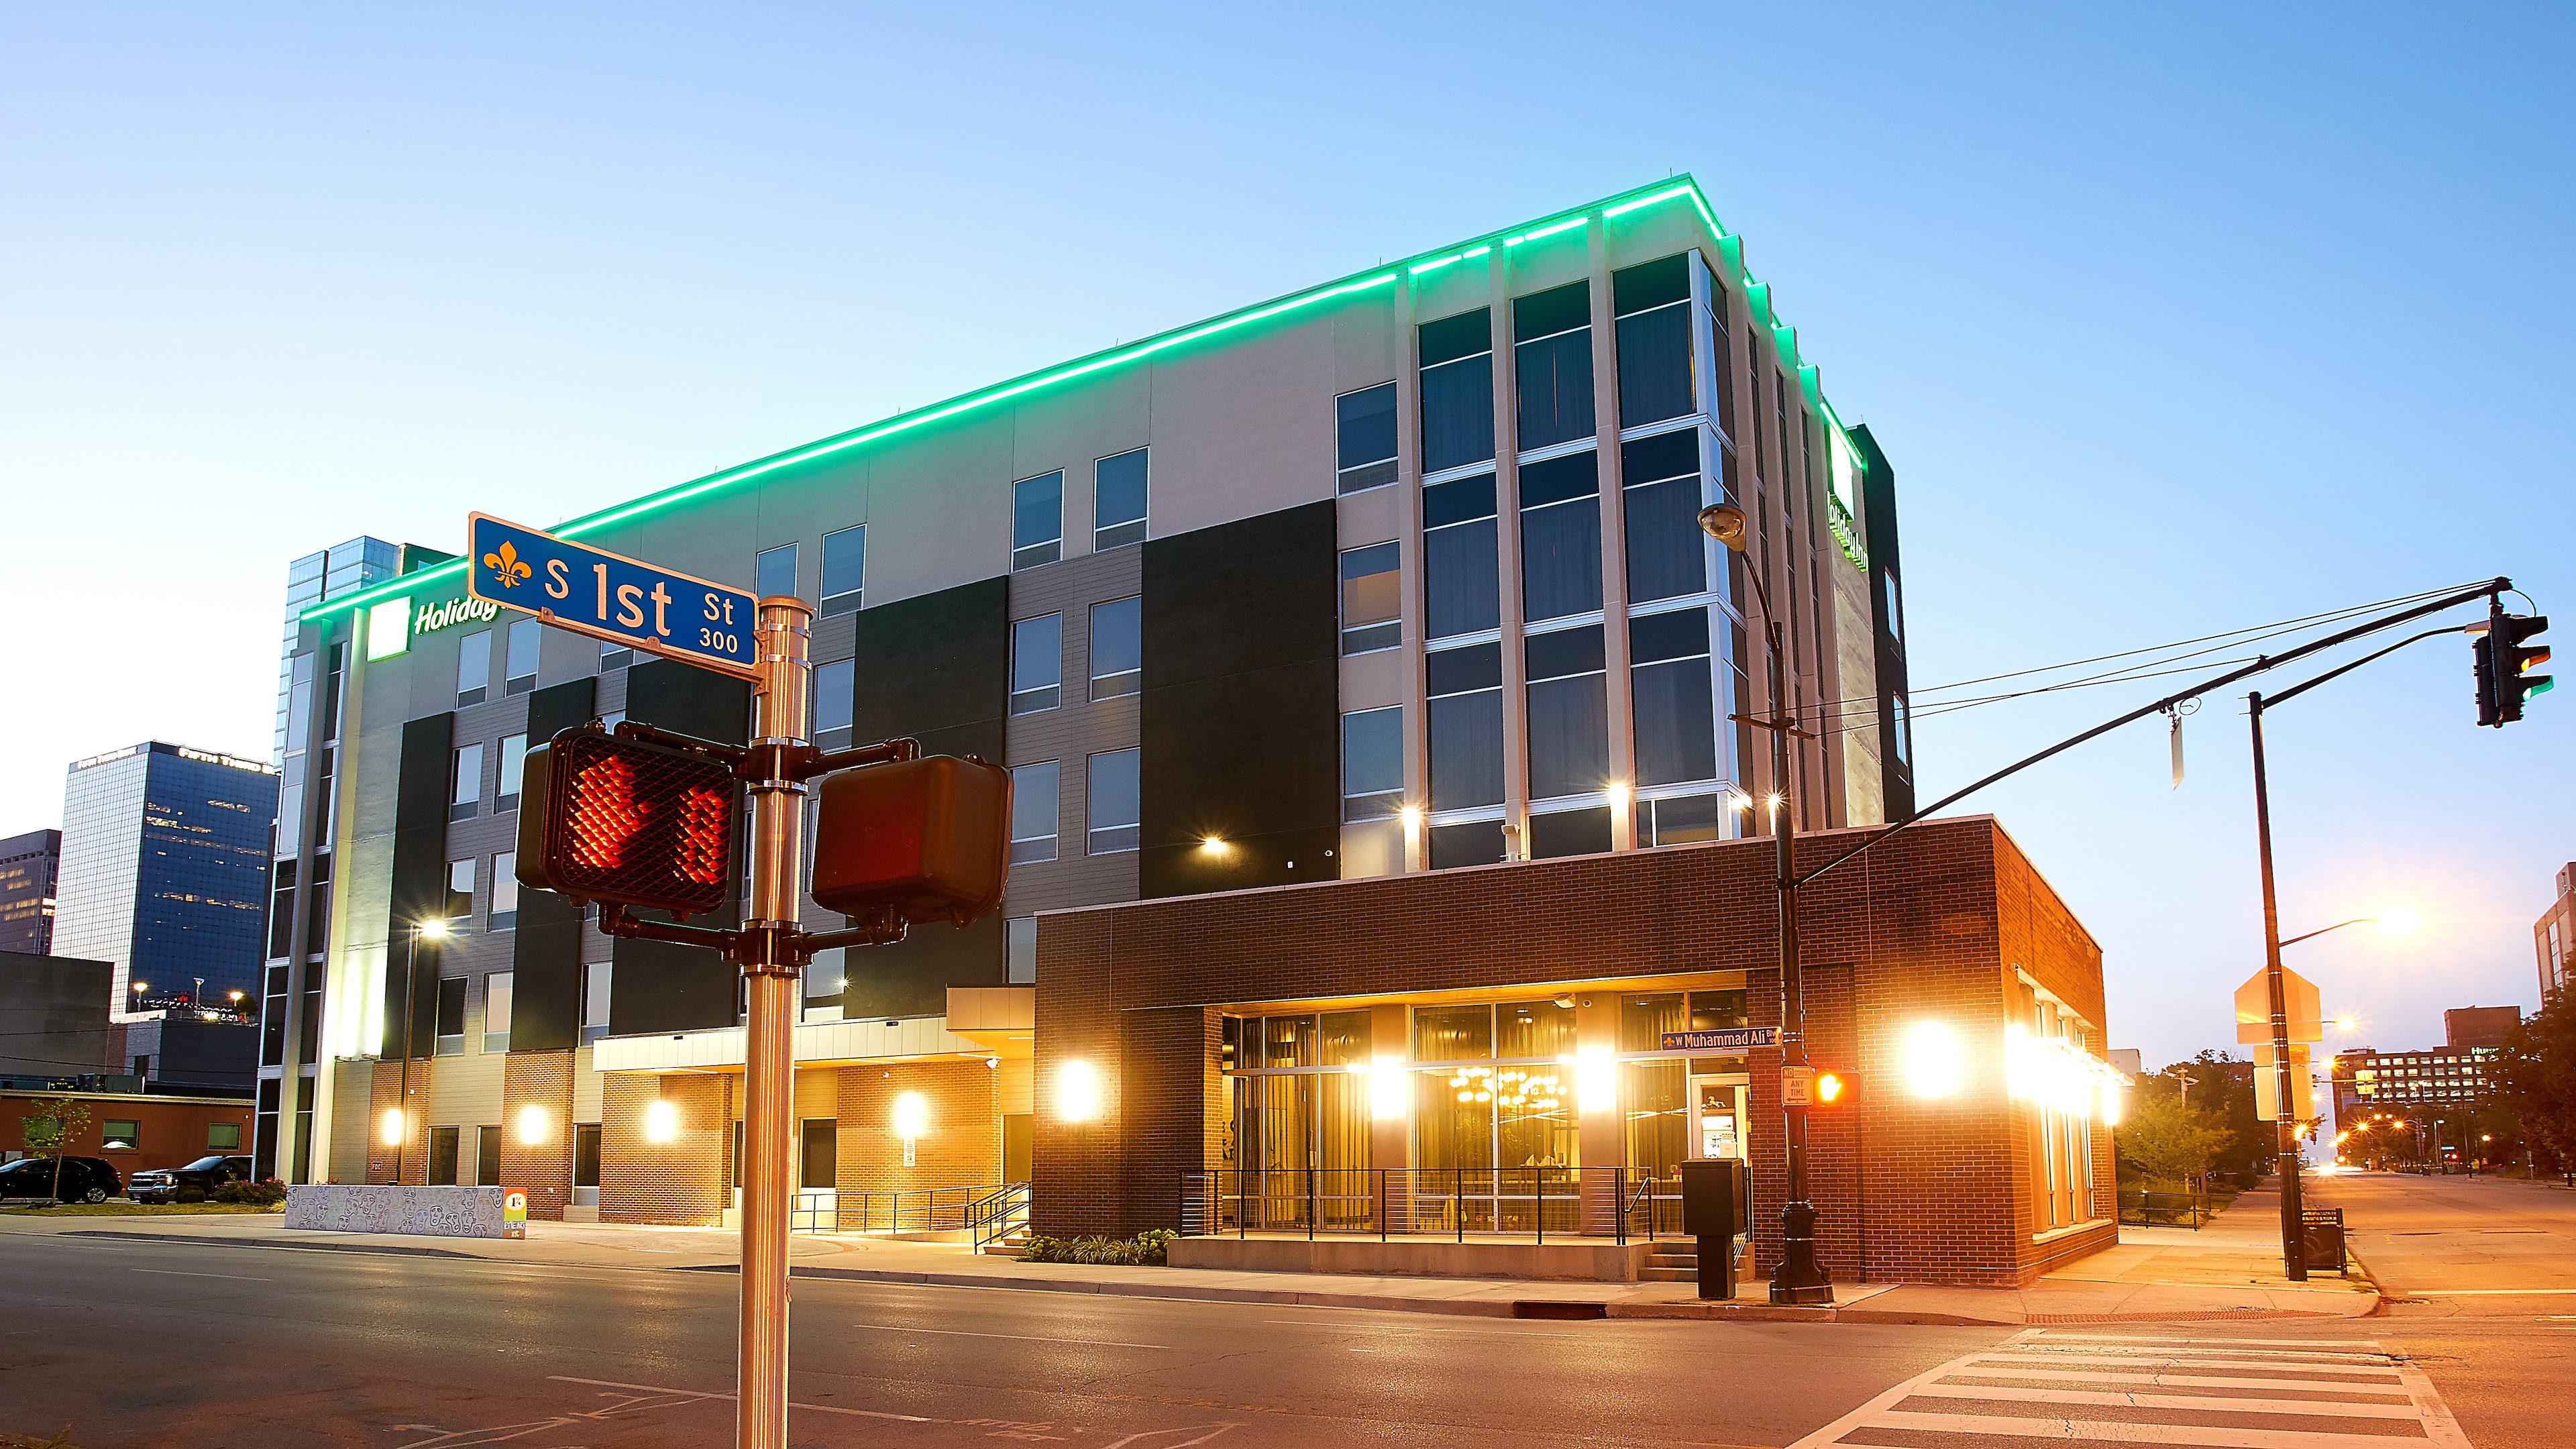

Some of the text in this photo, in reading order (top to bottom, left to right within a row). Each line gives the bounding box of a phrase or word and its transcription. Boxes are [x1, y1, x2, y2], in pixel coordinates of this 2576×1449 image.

[1856, 532, 1869, 572] Inn
[545, 559, 734, 637] S 1st St
[414, 594, 498, 635] Holiday
[699, 628, 739, 653] 300
[178, 747, 218, 764] FIFTH
[1675, 1036, 1682, 1046] W
[1684, 1031, 1748, 1048] Muhammad
[1750, 1030, 1766, 1044] Ali
[1784, 1069, 1793, 1077] NO
